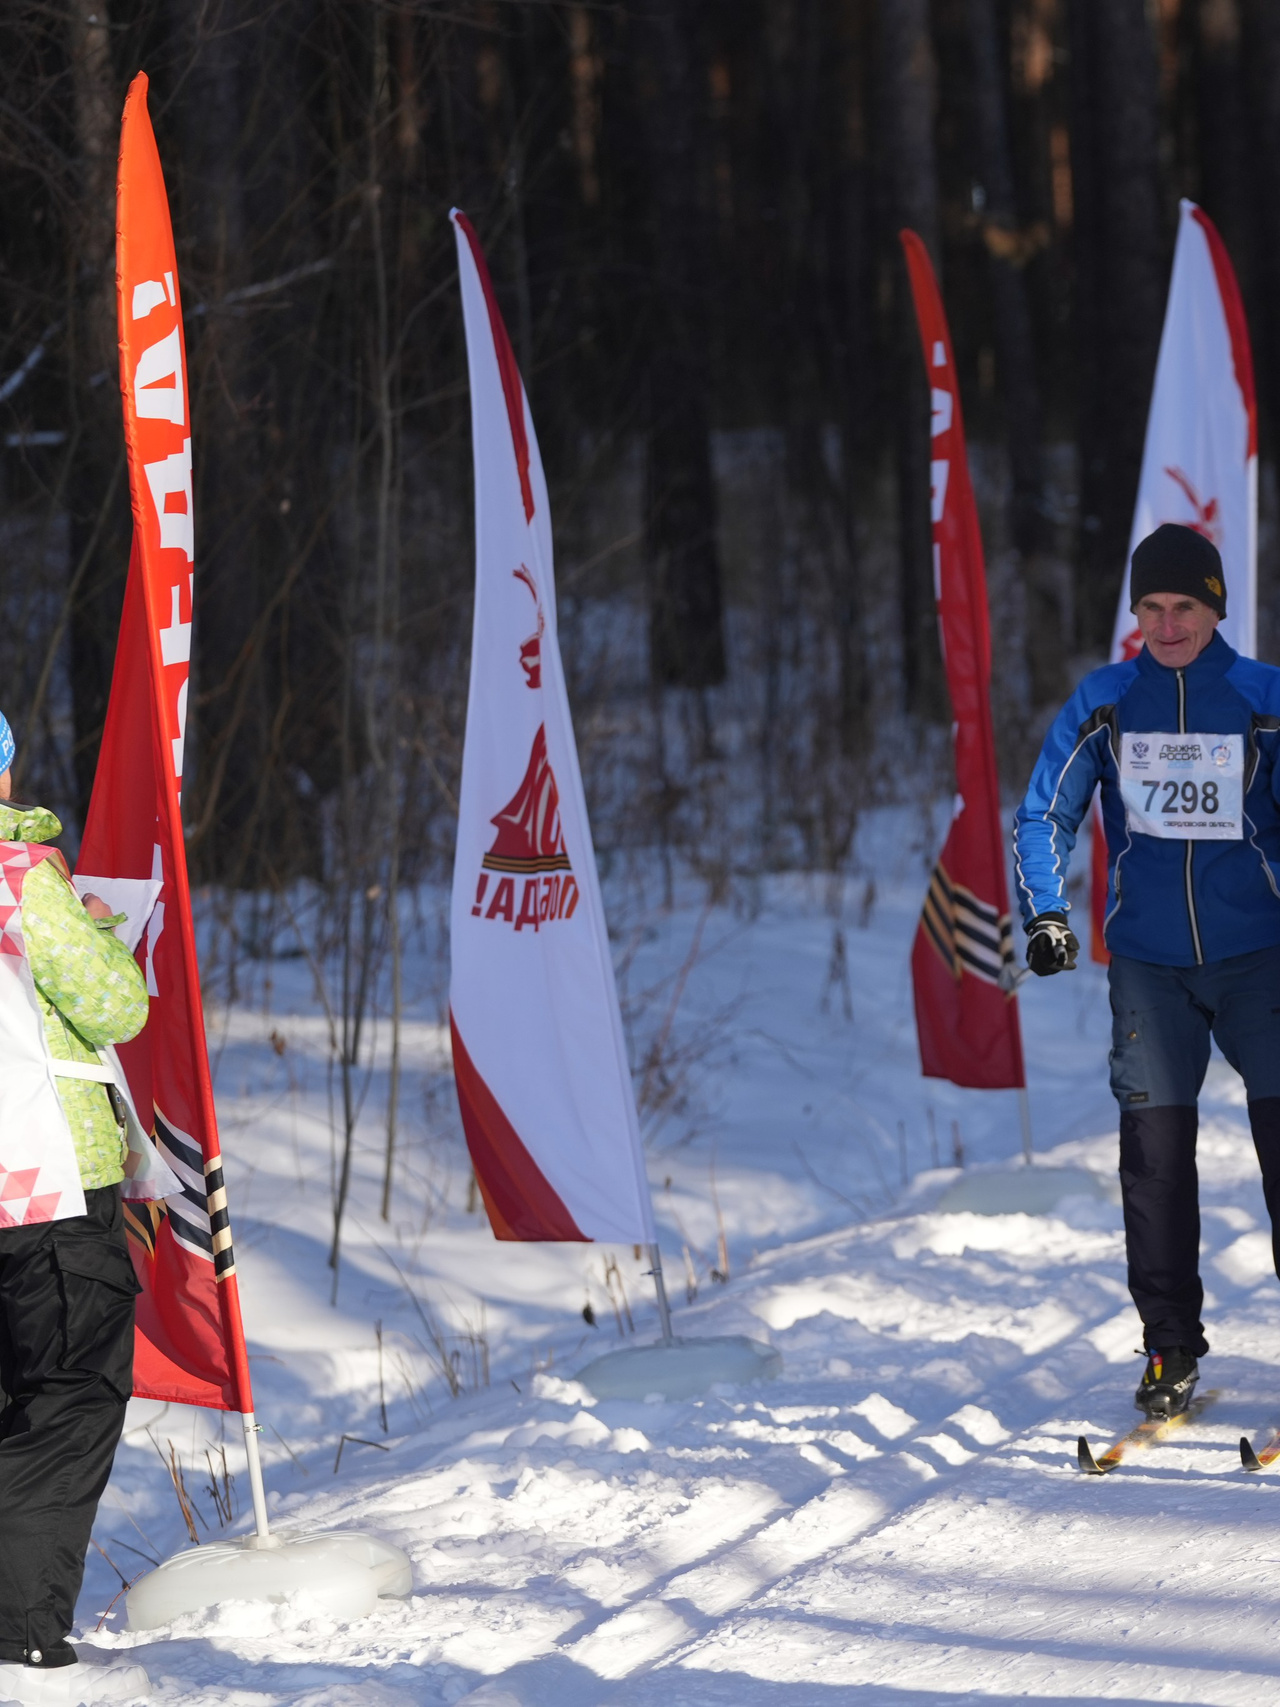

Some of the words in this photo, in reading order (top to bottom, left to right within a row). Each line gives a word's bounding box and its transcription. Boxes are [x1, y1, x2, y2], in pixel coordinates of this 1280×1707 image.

[1161, 744, 1201, 752] ЛЫЖНЯ
[1159, 753, 1202, 761] РОССИИ
[1141, 780, 1220, 815] 7298
